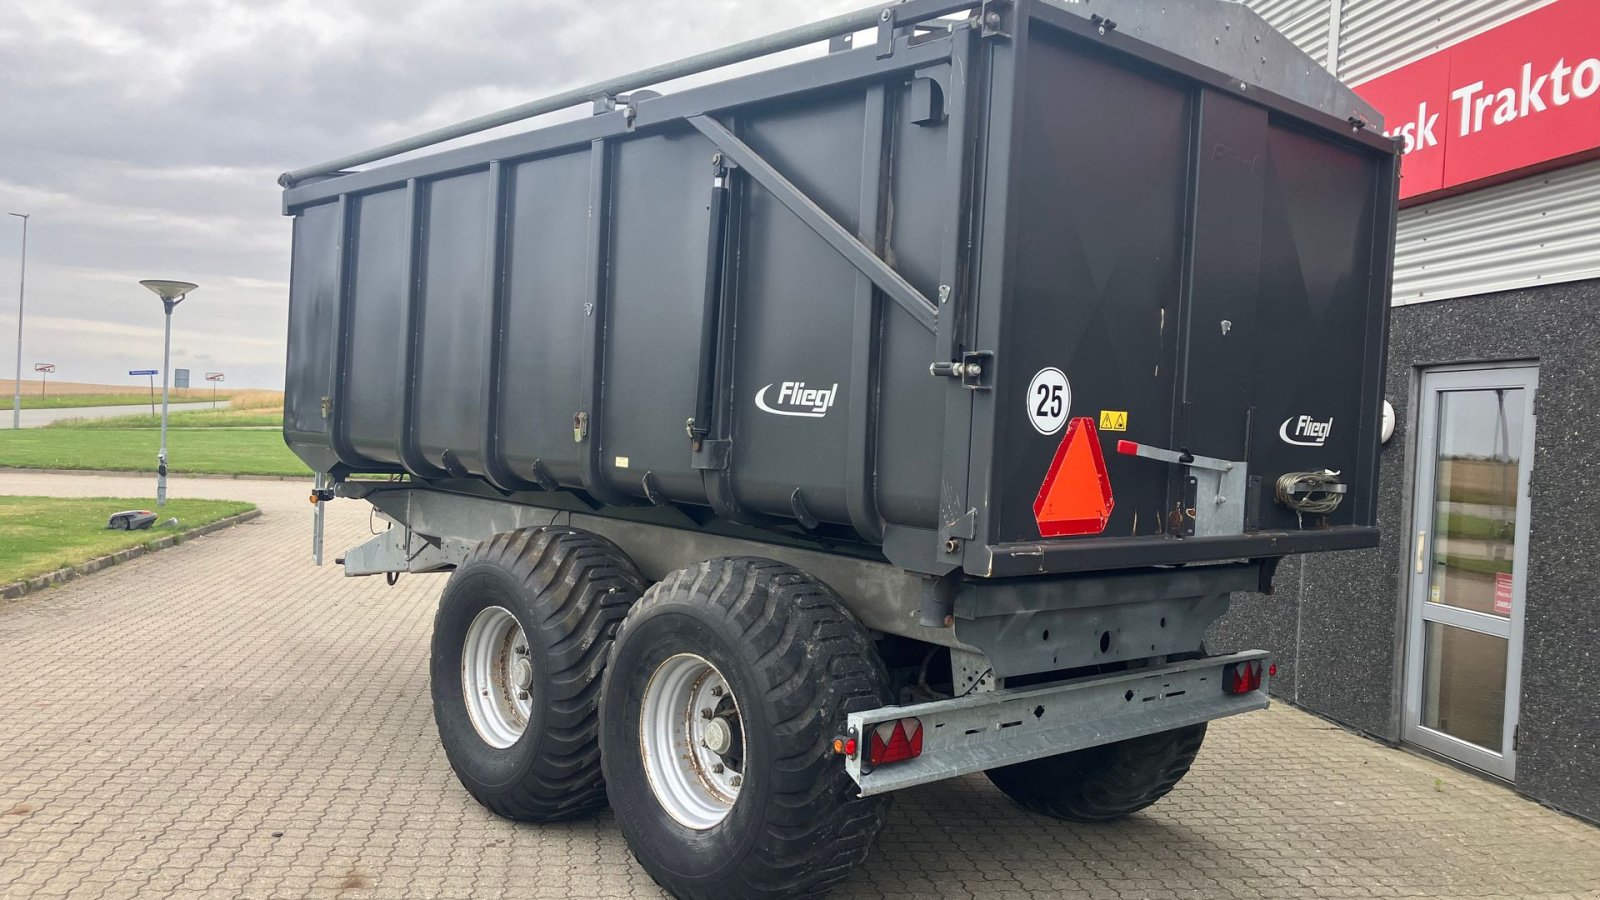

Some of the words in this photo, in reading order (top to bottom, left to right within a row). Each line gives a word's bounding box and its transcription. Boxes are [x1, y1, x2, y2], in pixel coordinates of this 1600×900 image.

[1383, 101, 1440, 155] sk
[1451, 57, 1600, 137] Trakto
[777, 381, 839, 413] Fliegl
[1036, 383, 1063, 418] 25
[1295, 415, 1333, 442] Fliegl
